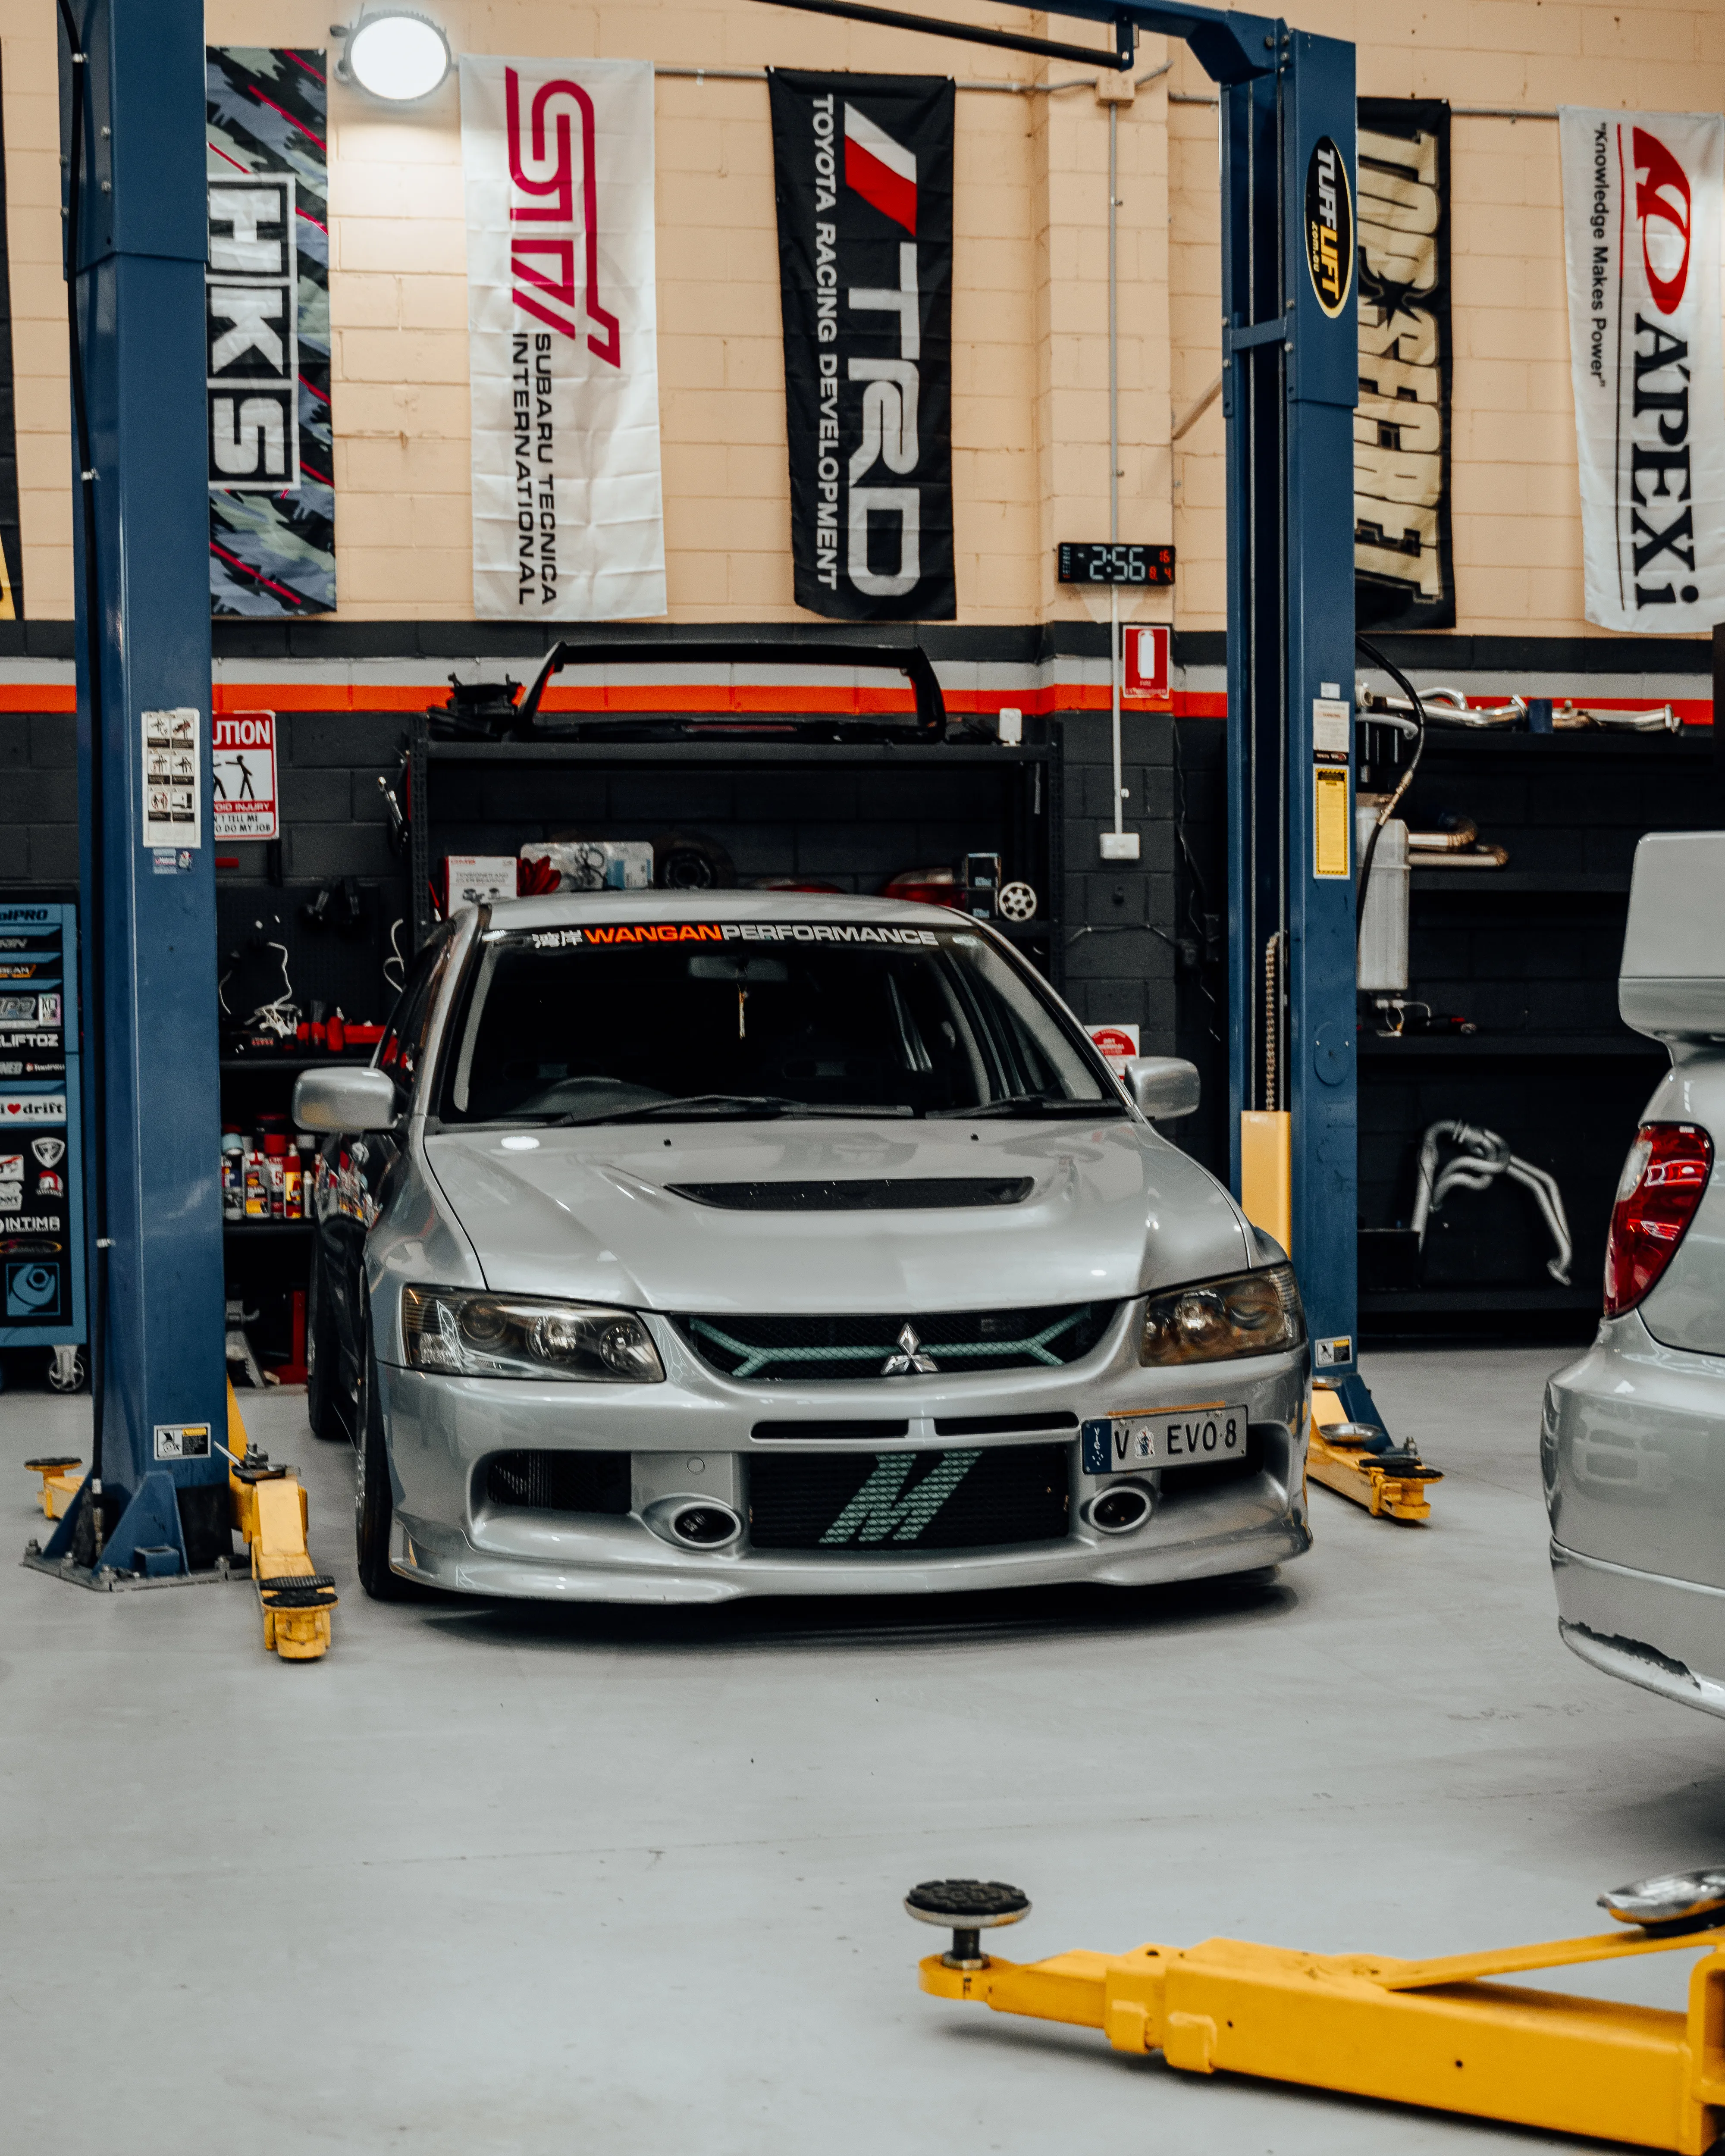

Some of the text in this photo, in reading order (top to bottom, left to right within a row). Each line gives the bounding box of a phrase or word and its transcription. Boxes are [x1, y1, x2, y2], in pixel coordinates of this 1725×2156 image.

[1591, 247, 1608, 310] Makes
[210, 187, 285, 475] HKS
[812, 93, 839, 591] TOYOTA RACING DEVELOPMENT
[848, 241, 920, 597] TRD
[512, 332, 535, 605] INTERNATIONAL
[536, 333, 558, 605] SUBARU TECNICA
[225, 824, 237, 833] DO
[240, 824, 252, 832] MY
[256, 823, 270, 832] JOB
[228, 814, 243, 822] TELL
[235, 802, 270, 812] INJURY
[23, 1102, 62, 1114] drift
[1114, 1429, 1129, 1460] V
